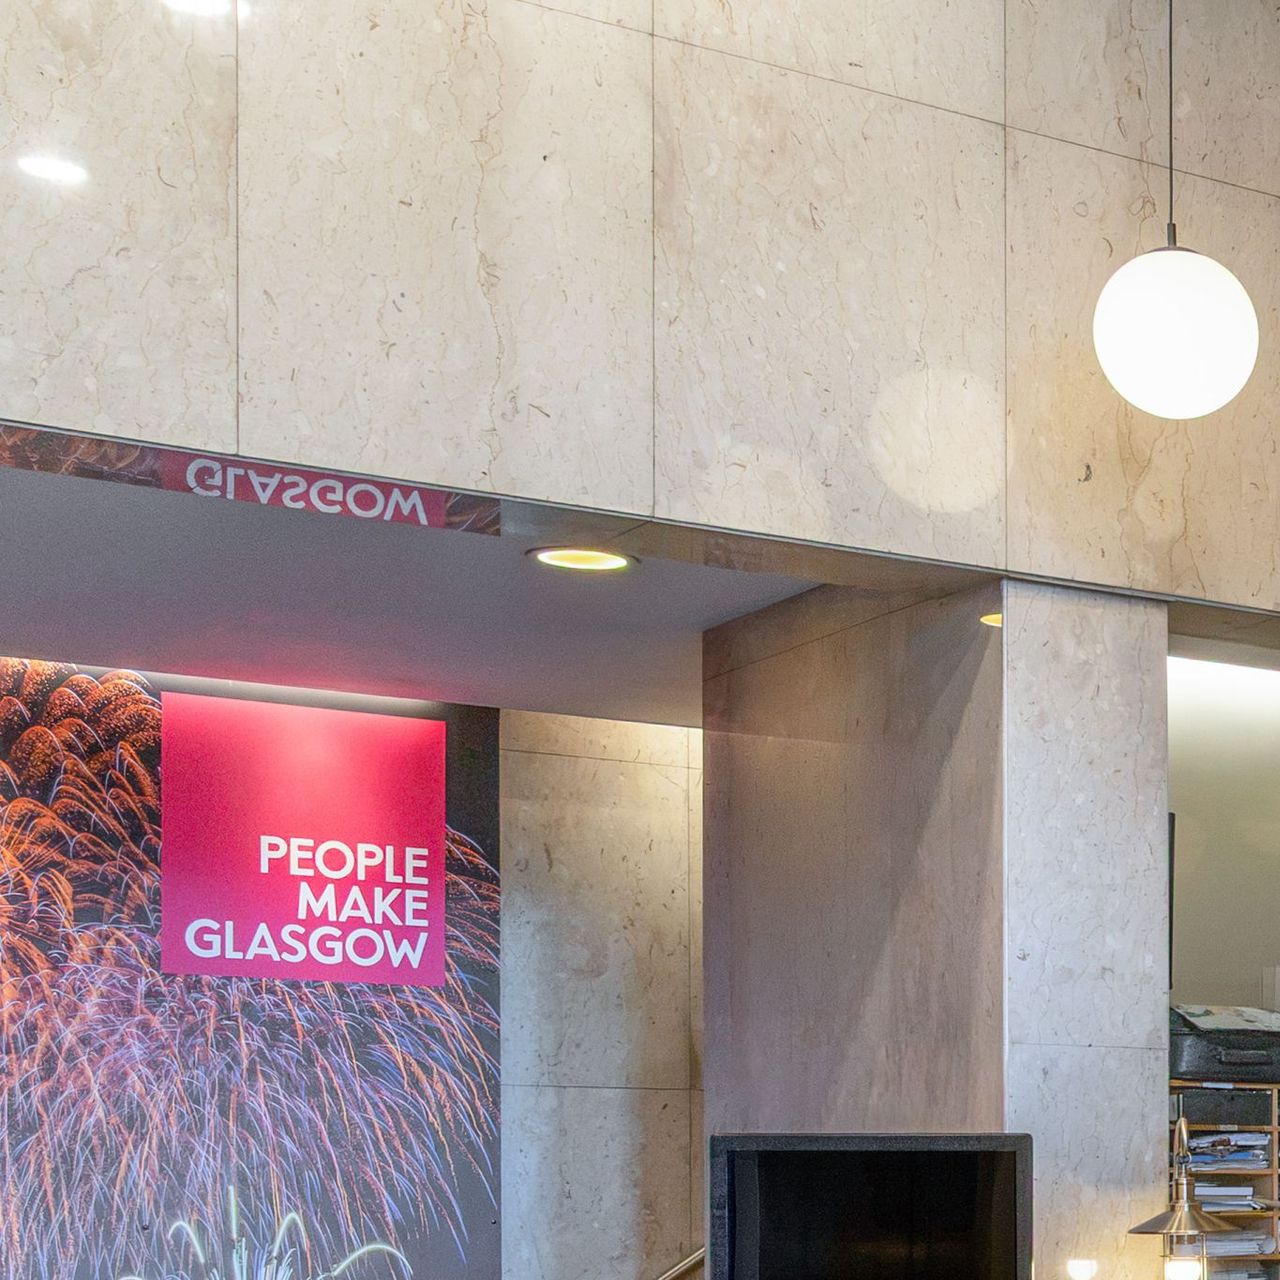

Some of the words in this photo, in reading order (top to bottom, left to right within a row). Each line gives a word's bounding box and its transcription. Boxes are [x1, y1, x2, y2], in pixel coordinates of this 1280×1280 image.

[259, 835, 429, 885] PEOPLE
[297, 881, 429, 927] MAKE
[184, 918, 428, 969] GLASGOW
